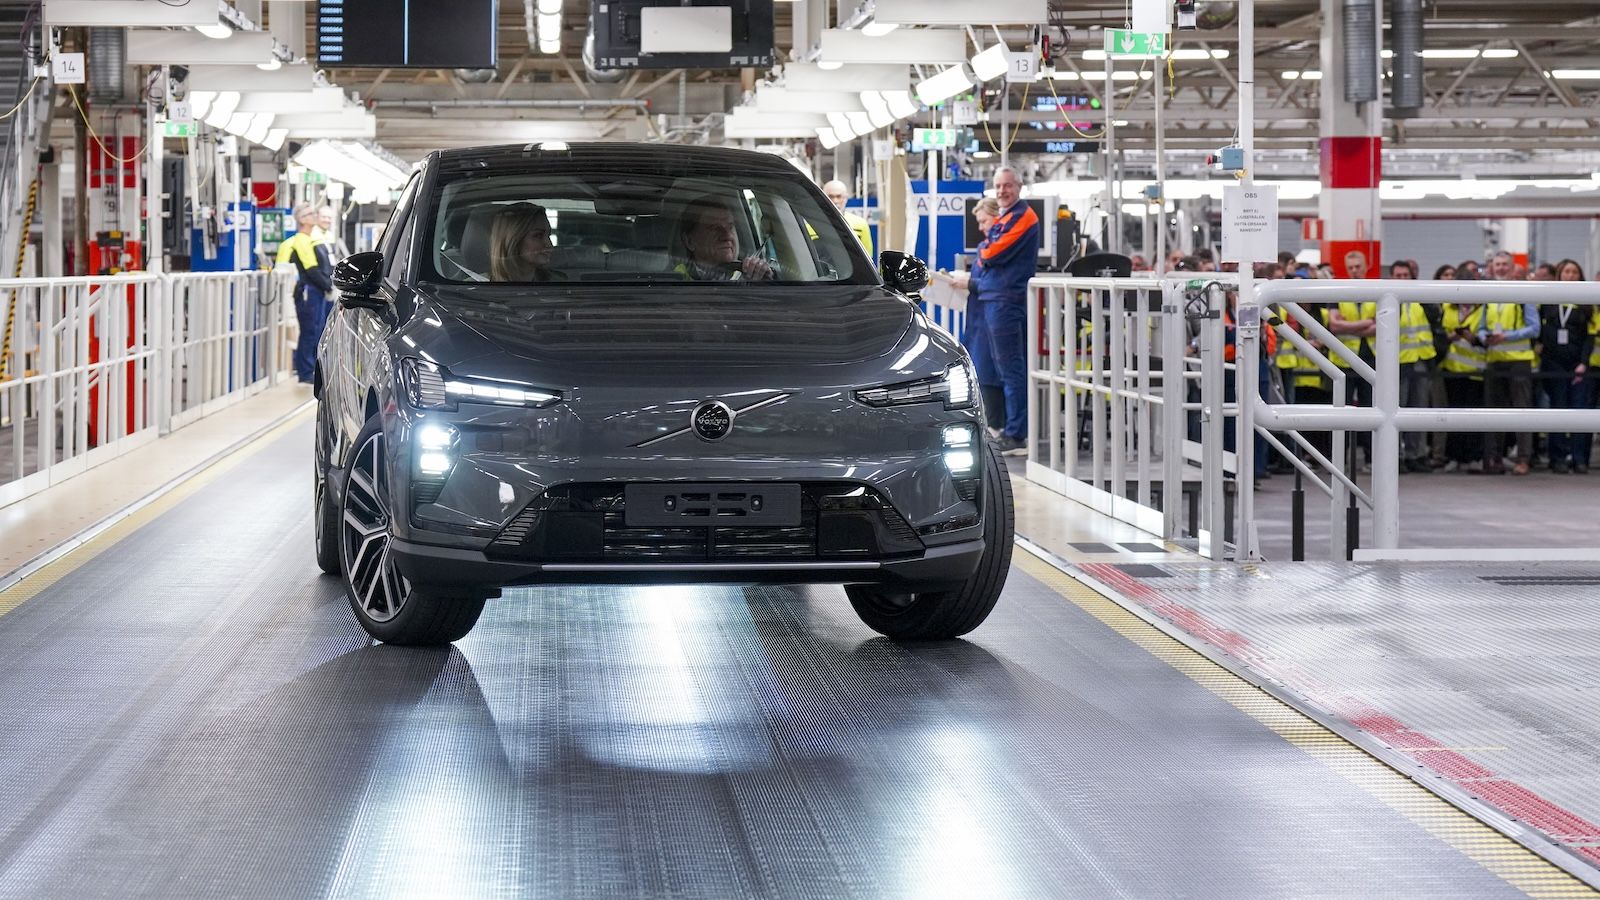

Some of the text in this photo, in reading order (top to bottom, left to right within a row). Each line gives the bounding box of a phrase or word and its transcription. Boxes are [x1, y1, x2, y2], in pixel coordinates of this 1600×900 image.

[62, 60, 76, 73] 14
[1016, 59, 1029, 72] 13
[177, 106, 187, 118] 12
[1046, 142, 1075, 153] RAST
